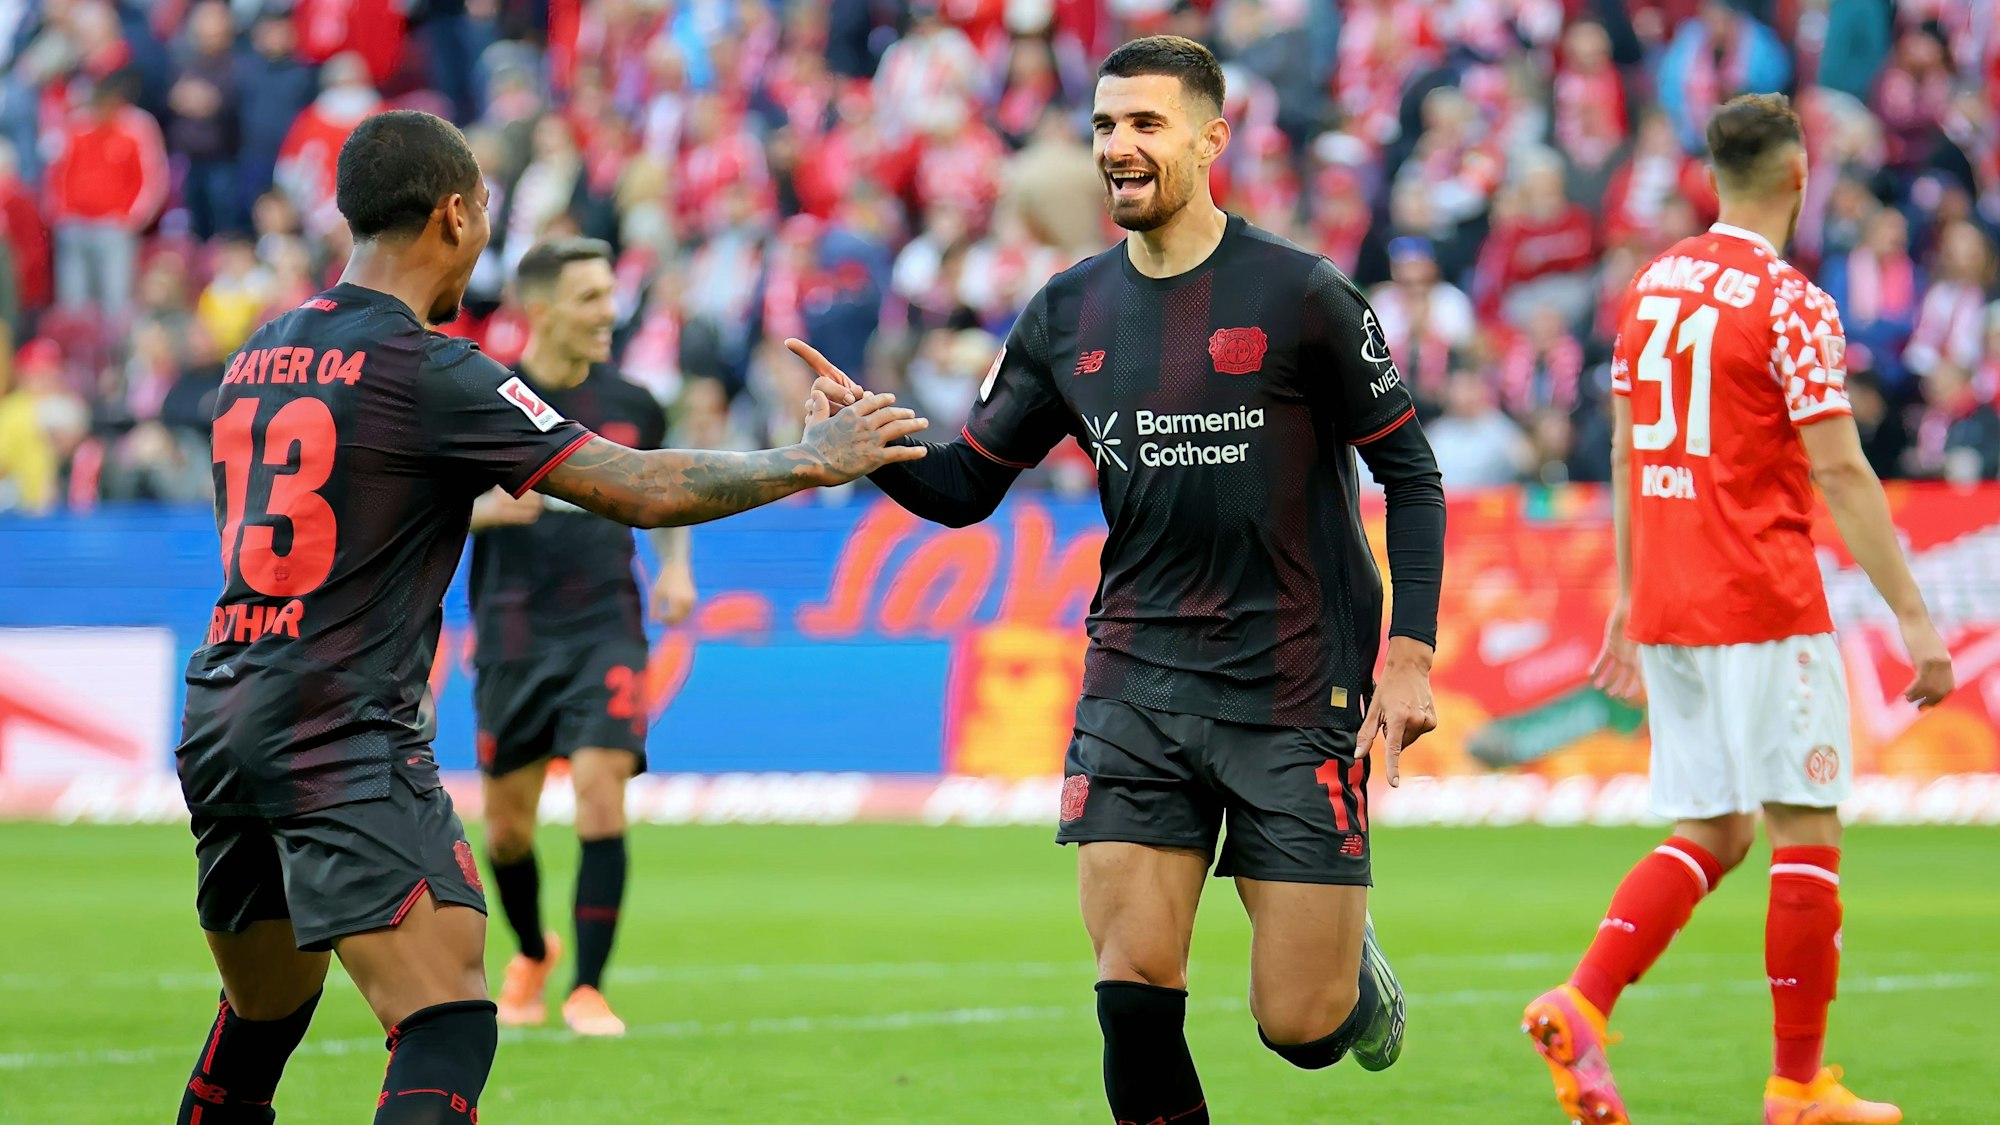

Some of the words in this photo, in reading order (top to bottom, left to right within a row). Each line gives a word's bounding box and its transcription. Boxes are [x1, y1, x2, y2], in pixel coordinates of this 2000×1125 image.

[1713, 267, 1760, 309] 05
[223, 346, 314, 386] BAYER
[316, 350, 367, 386] 04
[1632, 295, 1720, 457] 31
[1136, 404, 1265, 436] Barmenia
[1138, 439, 1250, 468] Gothaer
[212, 396, 337, 598] 13
[1642, 464, 1696, 500] KOH
[1315, 758, 1367, 832] 11
